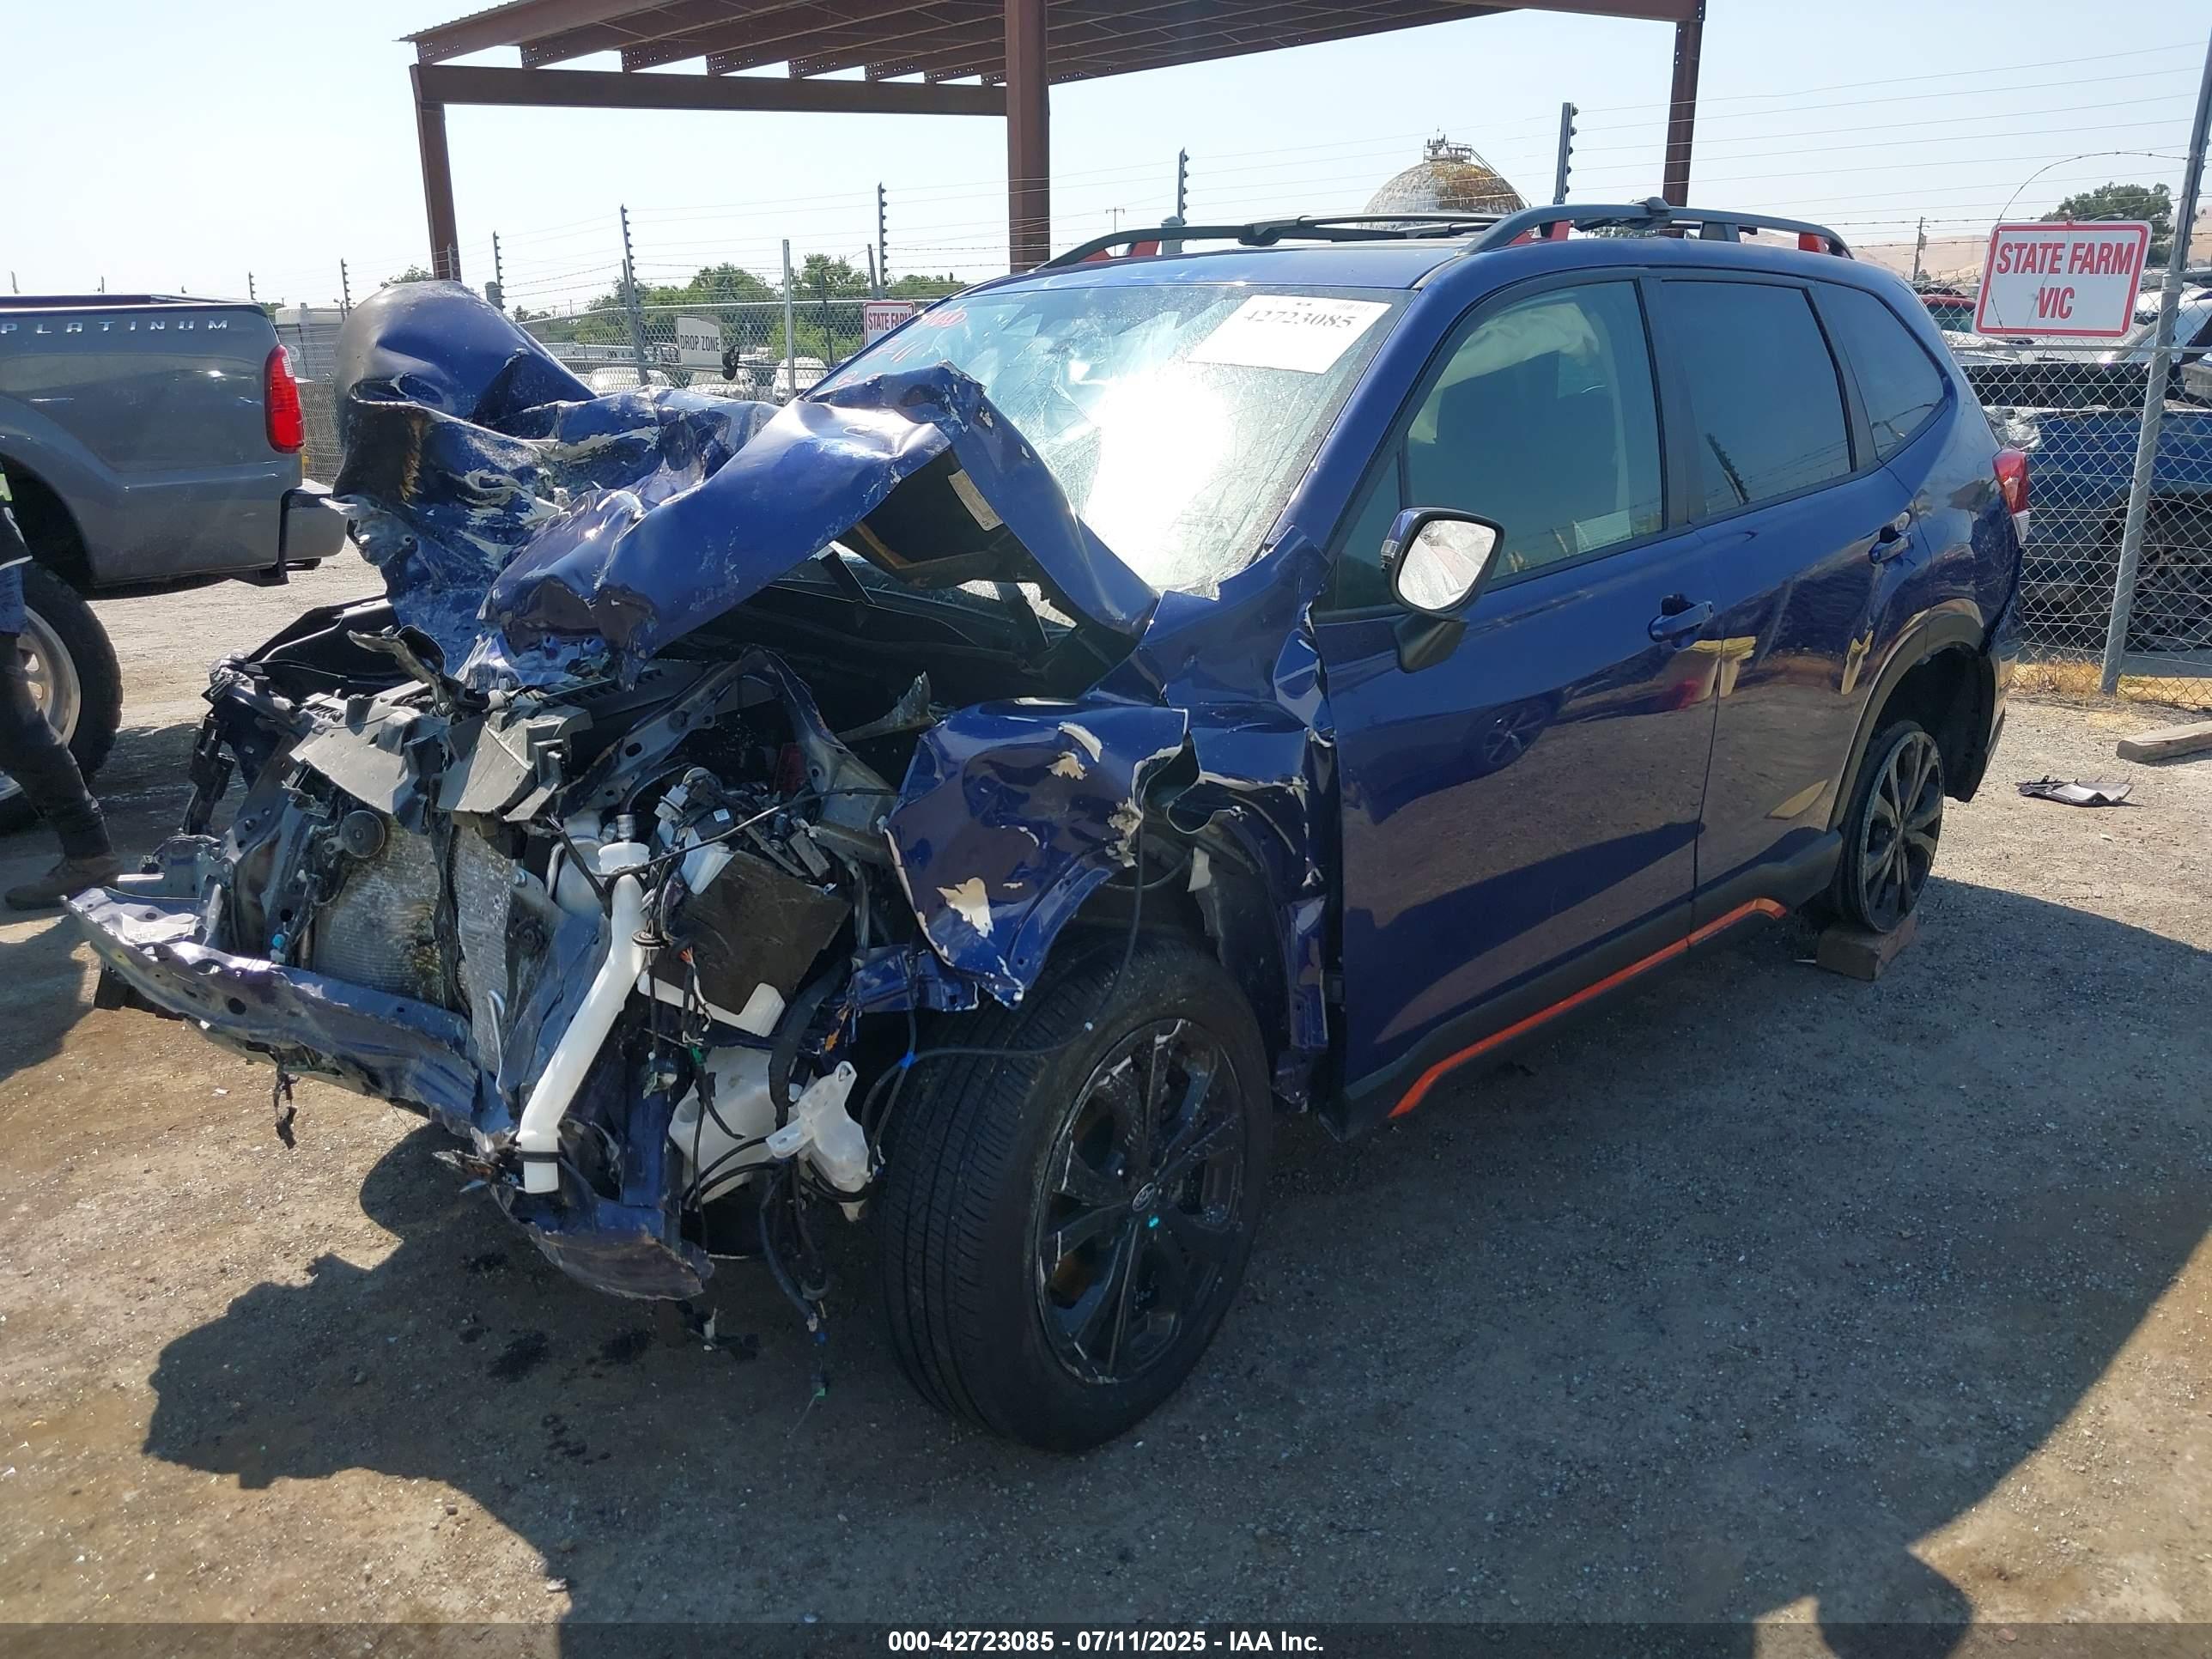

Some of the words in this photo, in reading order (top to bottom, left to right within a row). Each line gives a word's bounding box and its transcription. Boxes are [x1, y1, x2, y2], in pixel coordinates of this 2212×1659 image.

[1996, 242, 2065, 274] STATE
[2068, 242, 2136, 275] FARM
[2039, 287, 2075, 319] VIC
[0, 320, 228, 334] PLATINUM
[868, 312, 890, 331] STATE
[680, 335, 699, 350] DROP
[701, 336, 720, 352] ZONE
